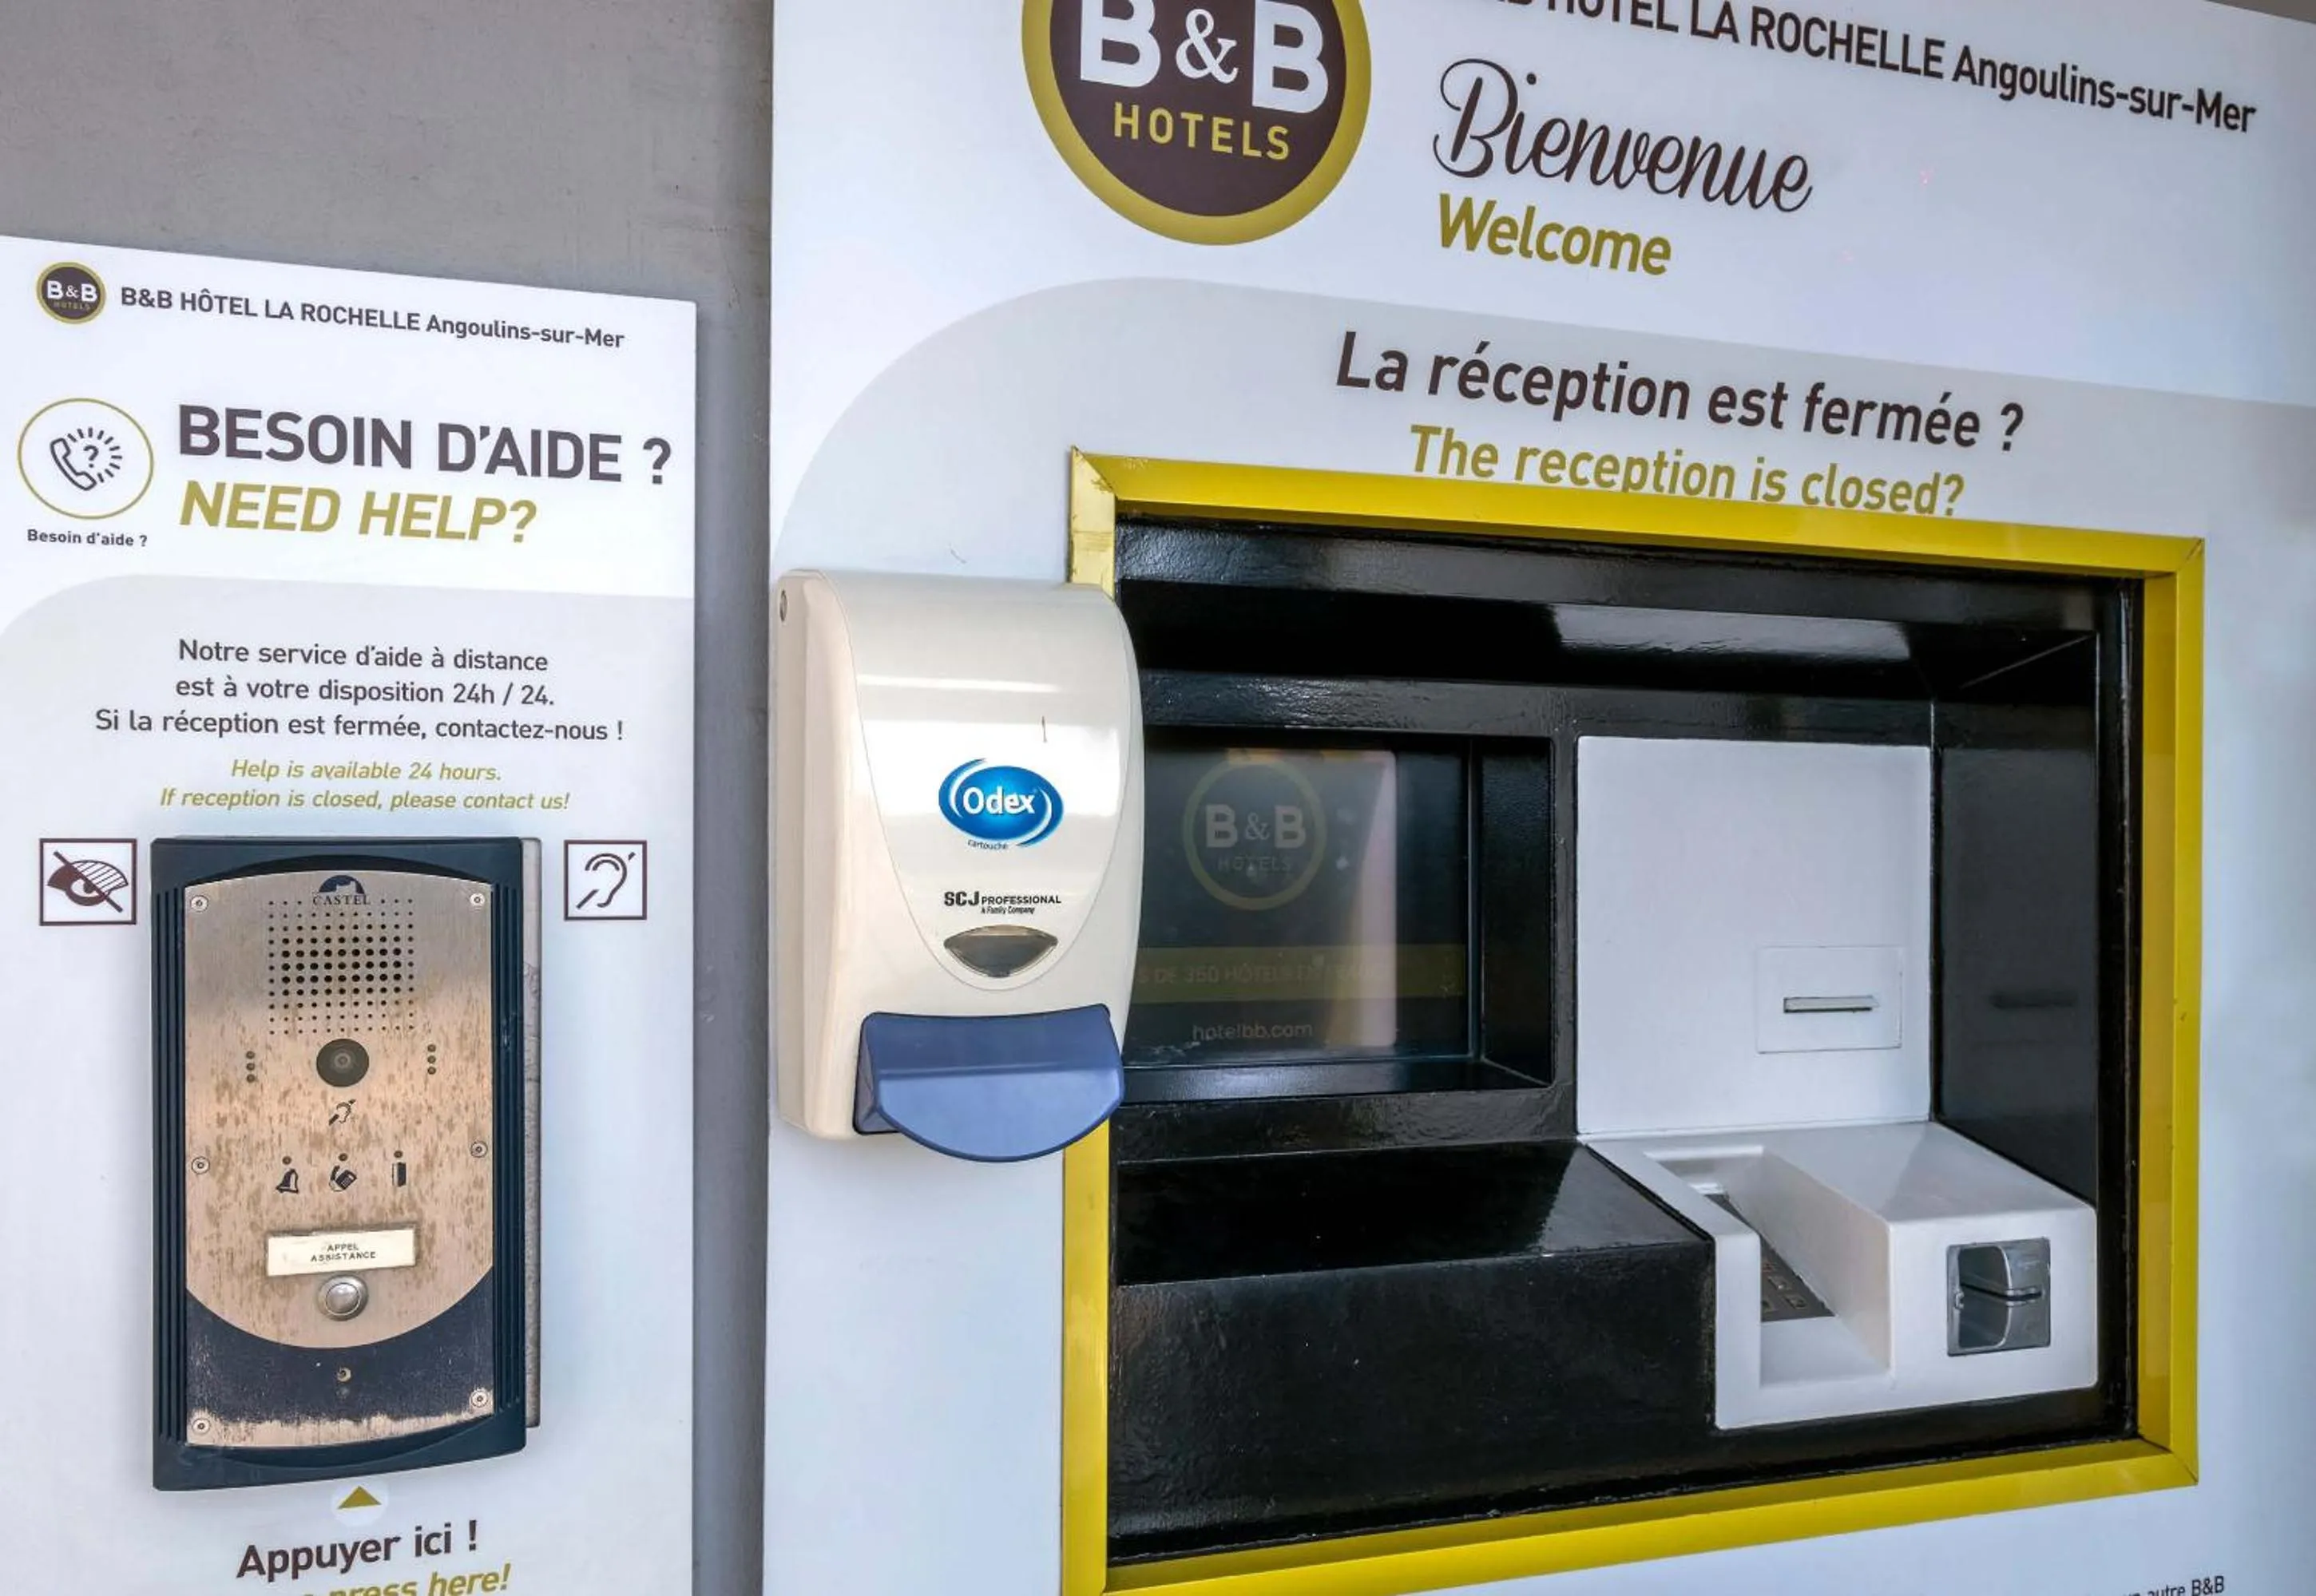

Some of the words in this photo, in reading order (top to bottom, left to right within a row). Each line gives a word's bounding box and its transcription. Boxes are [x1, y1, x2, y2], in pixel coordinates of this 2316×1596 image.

[1079, 0, 1329, 114] B&B
[1690, 0, 1740, 43] LA
[1751, 6, 1945, 78] ROCHELLE
[1952, 45, 2256, 133] Angoulins-sur-Mer
[1113, 101, 1291, 160] HOTELS
[1434, 58, 1813, 213] Bienvenue
[1439, 193, 1672, 275] Welcome
[46, 280, 97, 302] B&B
[121, 287, 173, 309] B&B
[180, 289, 258, 317] HÔTEL
[264, 297, 294, 321] LA
[301, 301, 420, 330] ROCHELLE
[426, 315, 625, 347] Angoulins-sur-Mer
[1337, 331, 1408, 391] La
[1428, 341, 1690, 422] réception
[1708, 380, 1787, 430] est
[1803, 382, 1981, 449] fermée
[2001, 402, 2024, 452] ?
[179, 405, 413, 469] BESOIN
[643, 438, 672, 484] ?
[1410, 424, 1499, 478] The
[1514, 447, 1736, 500] reception
[1750, 456, 1788, 503] is
[1800, 462, 1965, 516] closed?
[180, 481, 341, 533] NEED
[359, 491, 537, 543] HELP?
[27, 529, 81, 544] Besoin
[139, 535, 148, 547] ?
[179, 639, 249, 662] Notre
[259, 643, 346, 664] service
[432, 647, 444, 668] à
[454, 649, 548, 671] distance
[176, 677, 214, 696] est
[224, 675, 237, 697] à
[247, 679, 309, 699] votre
[319, 679, 444, 705] disposition
[454, 683, 494, 704] 24h
[502, 683, 514, 706] /
[521, 685, 554, 705] 24.
[95, 709, 118, 731] Si
[129, 710, 152, 731] la
[162, 710, 279, 738] réception
[288, 716, 325, 734] est
[335, 715, 426, 740] fermée,
[436, 719, 608, 740] contactez-nous
[617, 721, 623, 740] !
[232, 759, 280, 782] Help
[287, 761, 304, 778] is
[311, 762, 401, 779] available
[408, 762, 432, 780] 24
[440, 763, 502, 781] hours.
[160, 787, 176, 806] If
[181, 789, 280, 810] reception
[288, 790, 305, 807] is
[312, 790, 382, 810] closed,
[390, 791, 456, 811] please
[463, 794, 533, 809] contact
[540, 792, 570, 810] us!
[963, 786, 1036, 814] Odex
[1206, 805, 1306, 849] B&B
[944, 891, 980, 906] SCJ
[982, 896, 1061, 905] PROFESSIONAL
[310, 1251, 377, 1262] ASSISTANCE
[327, 1243, 359, 1252] APPEL
[236, 1534, 401, 1582] Appuyer
[414, 1523, 451, 1557] ici
[468, 1520, 477, 1550] !
[427, 1562, 511, 1596] here!
[2191, 1575, 2224, 1596] B&B
